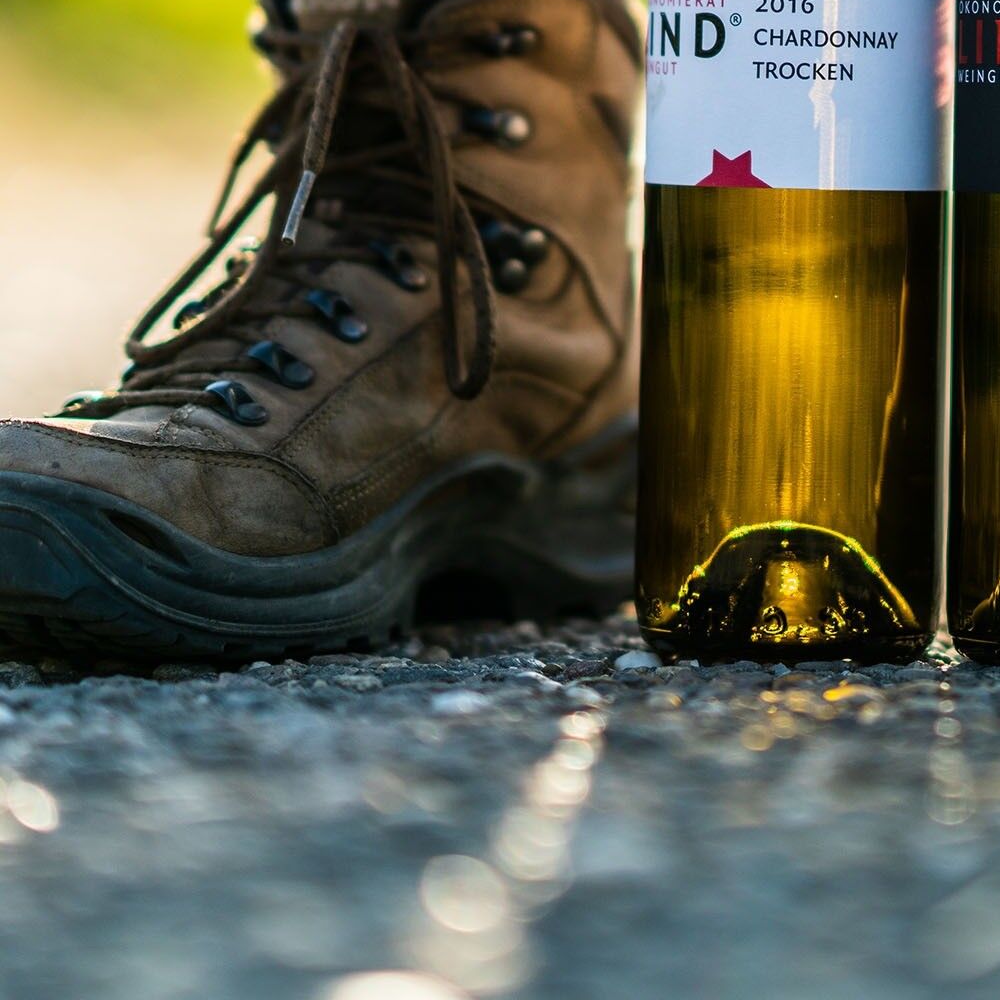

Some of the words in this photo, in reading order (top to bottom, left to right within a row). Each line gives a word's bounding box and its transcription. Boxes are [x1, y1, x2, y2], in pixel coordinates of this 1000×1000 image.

[650, 11, 742, 59] IND®
[753, 28, 899, 50] CHARDONNAY
[752, 61, 853, 81] TROCKEN
